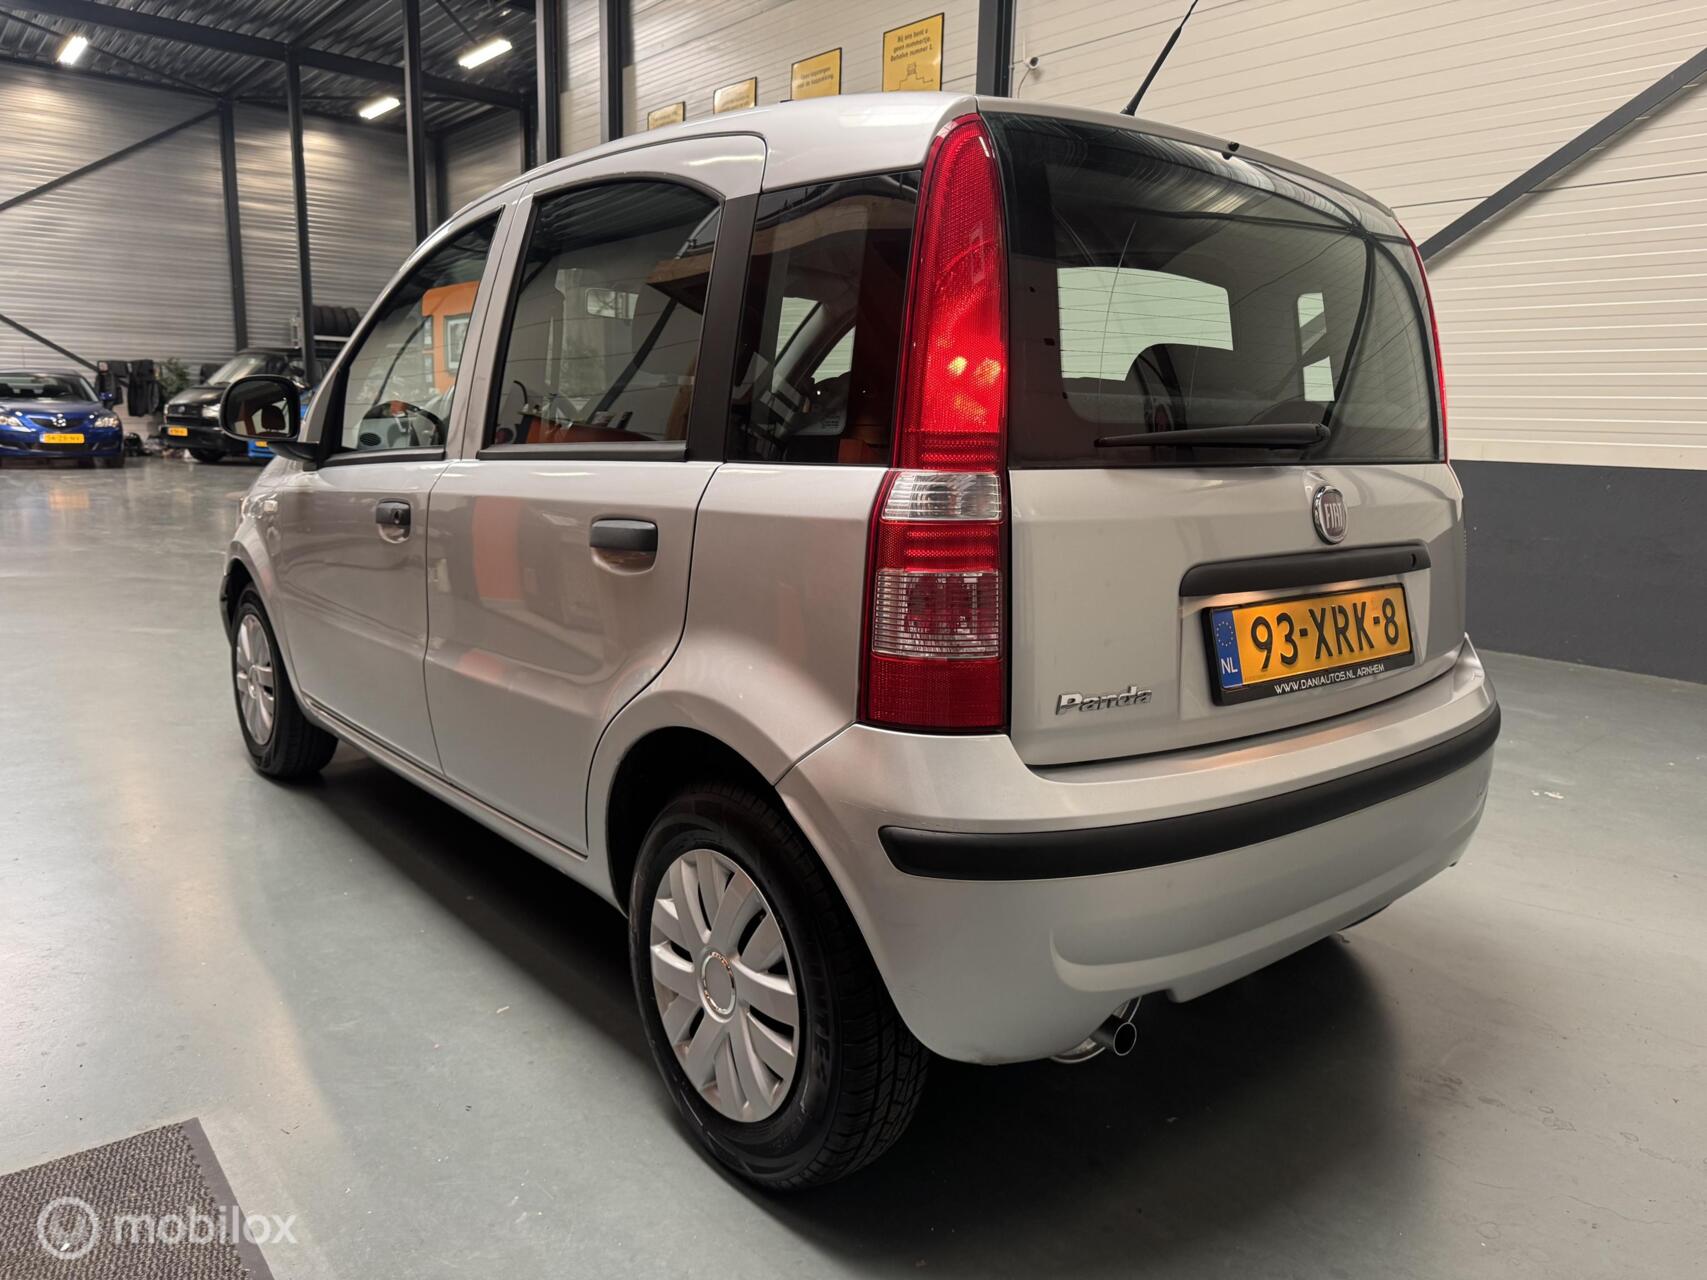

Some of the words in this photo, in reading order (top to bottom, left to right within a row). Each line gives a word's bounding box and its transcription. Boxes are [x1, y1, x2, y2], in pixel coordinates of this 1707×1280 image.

[1323, 503, 1343, 529] FIAT
[1250, 598, 1399, 672] 93-XRK-8
[1220, 656, 1239, 675] NL
[1274, 669, 1356, 694] WWW.DANIAUTOS.NL
[1356, 663, 1385, 680] ARNHEM
[1055, 685, 1153, 716] Panda
